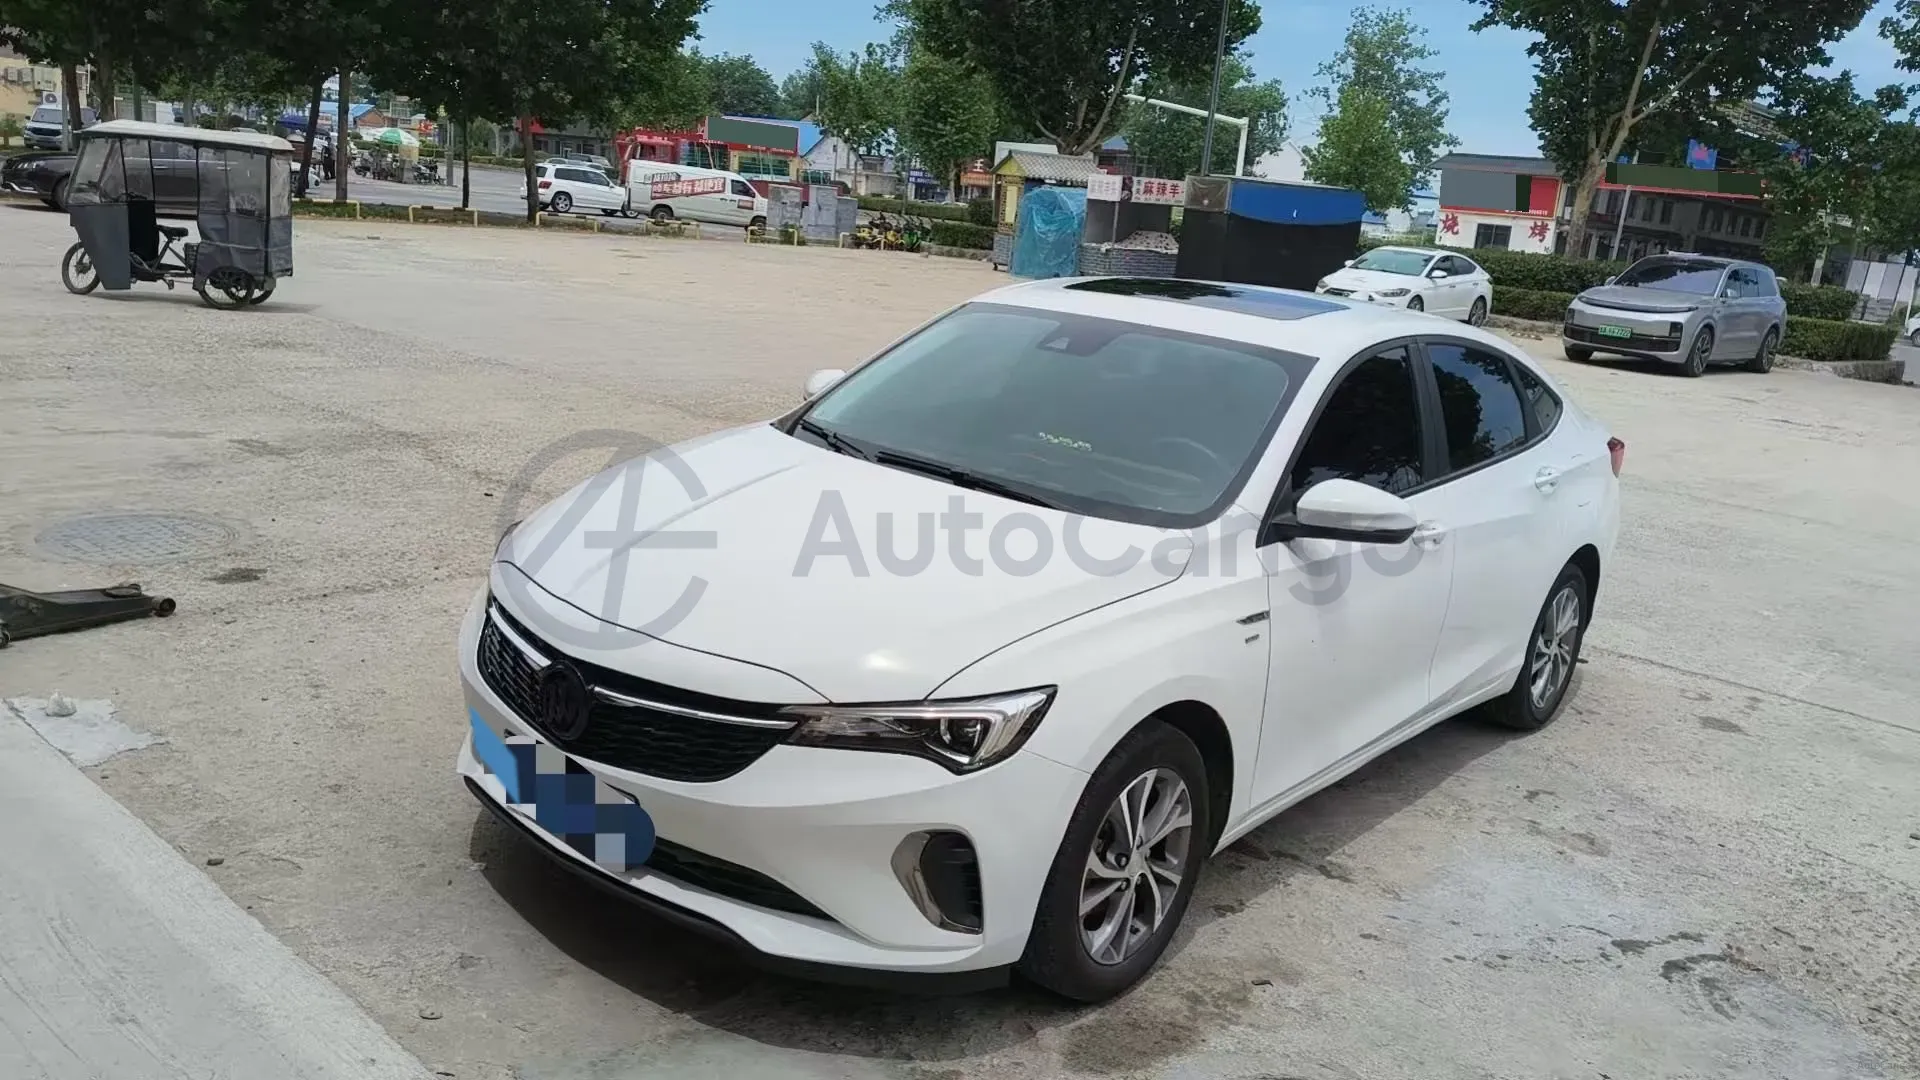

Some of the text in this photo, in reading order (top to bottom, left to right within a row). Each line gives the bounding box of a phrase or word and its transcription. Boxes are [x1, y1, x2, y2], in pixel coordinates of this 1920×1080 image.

[1143, 181, 1184, 198] 麻辣羊
[1440, 213, 1550, 243] 烧 烤
